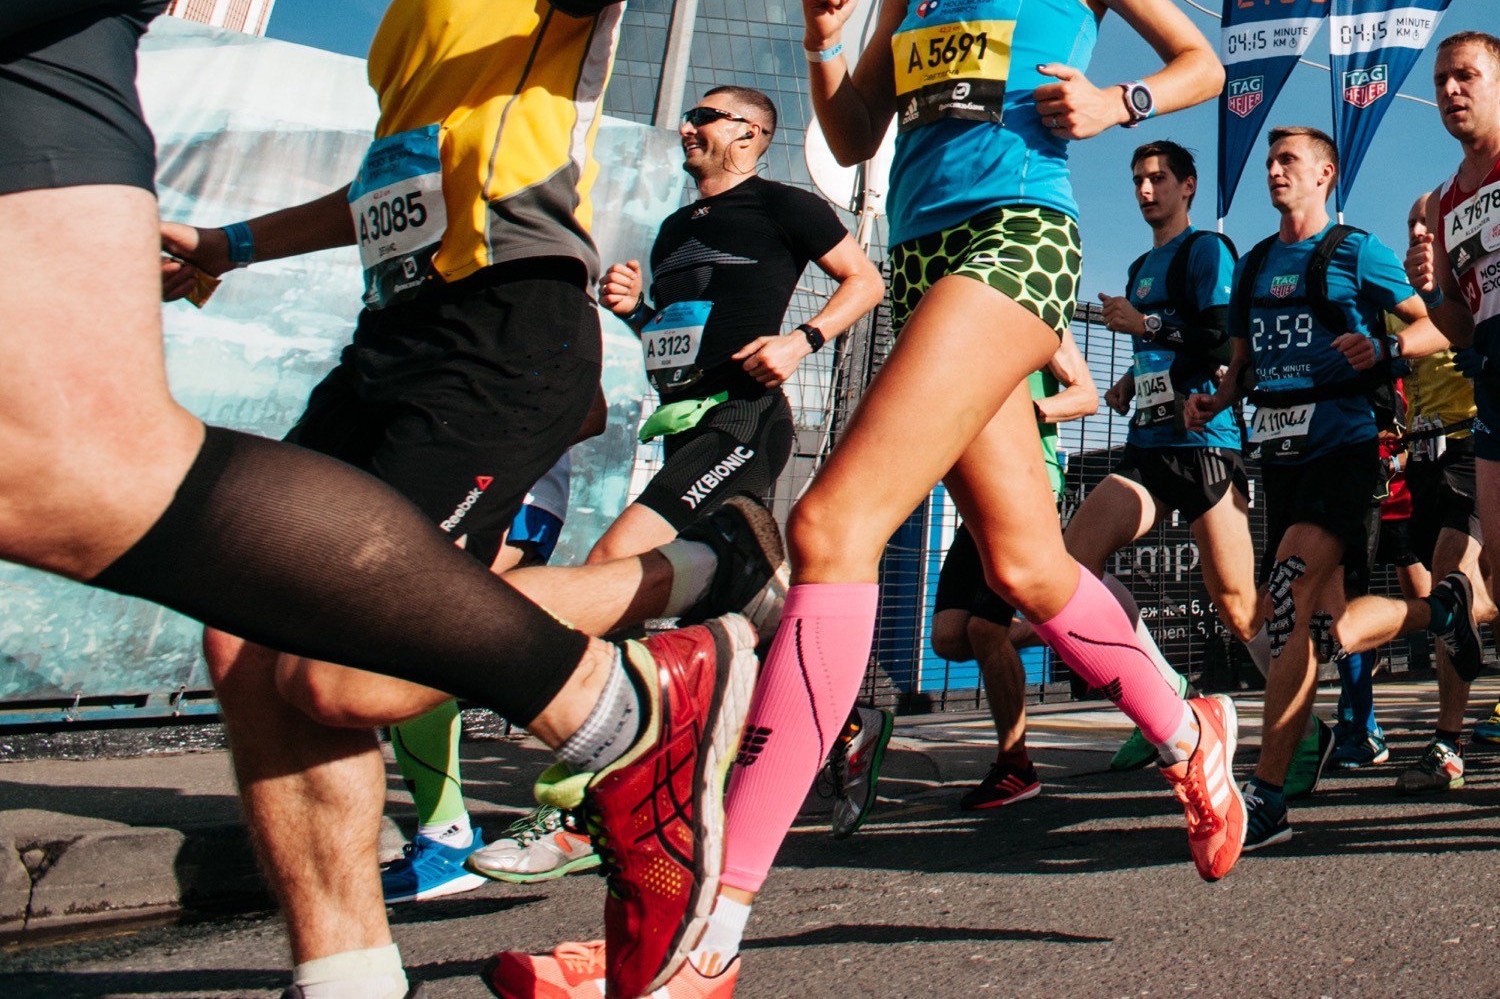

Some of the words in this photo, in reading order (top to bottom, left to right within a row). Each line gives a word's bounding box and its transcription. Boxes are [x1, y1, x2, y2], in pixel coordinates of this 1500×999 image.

[1273, 27, 1309, 38] MINUTE
[1340, 20, 1388, 45] 04:15
[1396, 18, 1431, 29] MINUTE
[1396, 27, 1411, 37] KM
[908, 41, 924, 74] A
[927, 31, 988, 67] 5691
[1228, 30, 1267, 54] 04:15
[1273, 38, 1287, 48] KM
[1346, 67, 1384, 84] TAG
[1230, 78, 1261, 95] TAG
[1344, 82, 1386, 106] HEUER
[1228, 92, 1262, 116] HEUER
[1451, 214, 1464, 236] A
[1465, 216, 1491, 237] ALEXANDER
[1275, 276, 1297, 284] TAG
[1252, 313, 1313, 352] 2:59
[647, 338, 656, 359] A
[657, 333, 691, 357] 3123
[1282, 363, 1311, 373] MINUTE
[439, 487, 484, 533] Reebok
